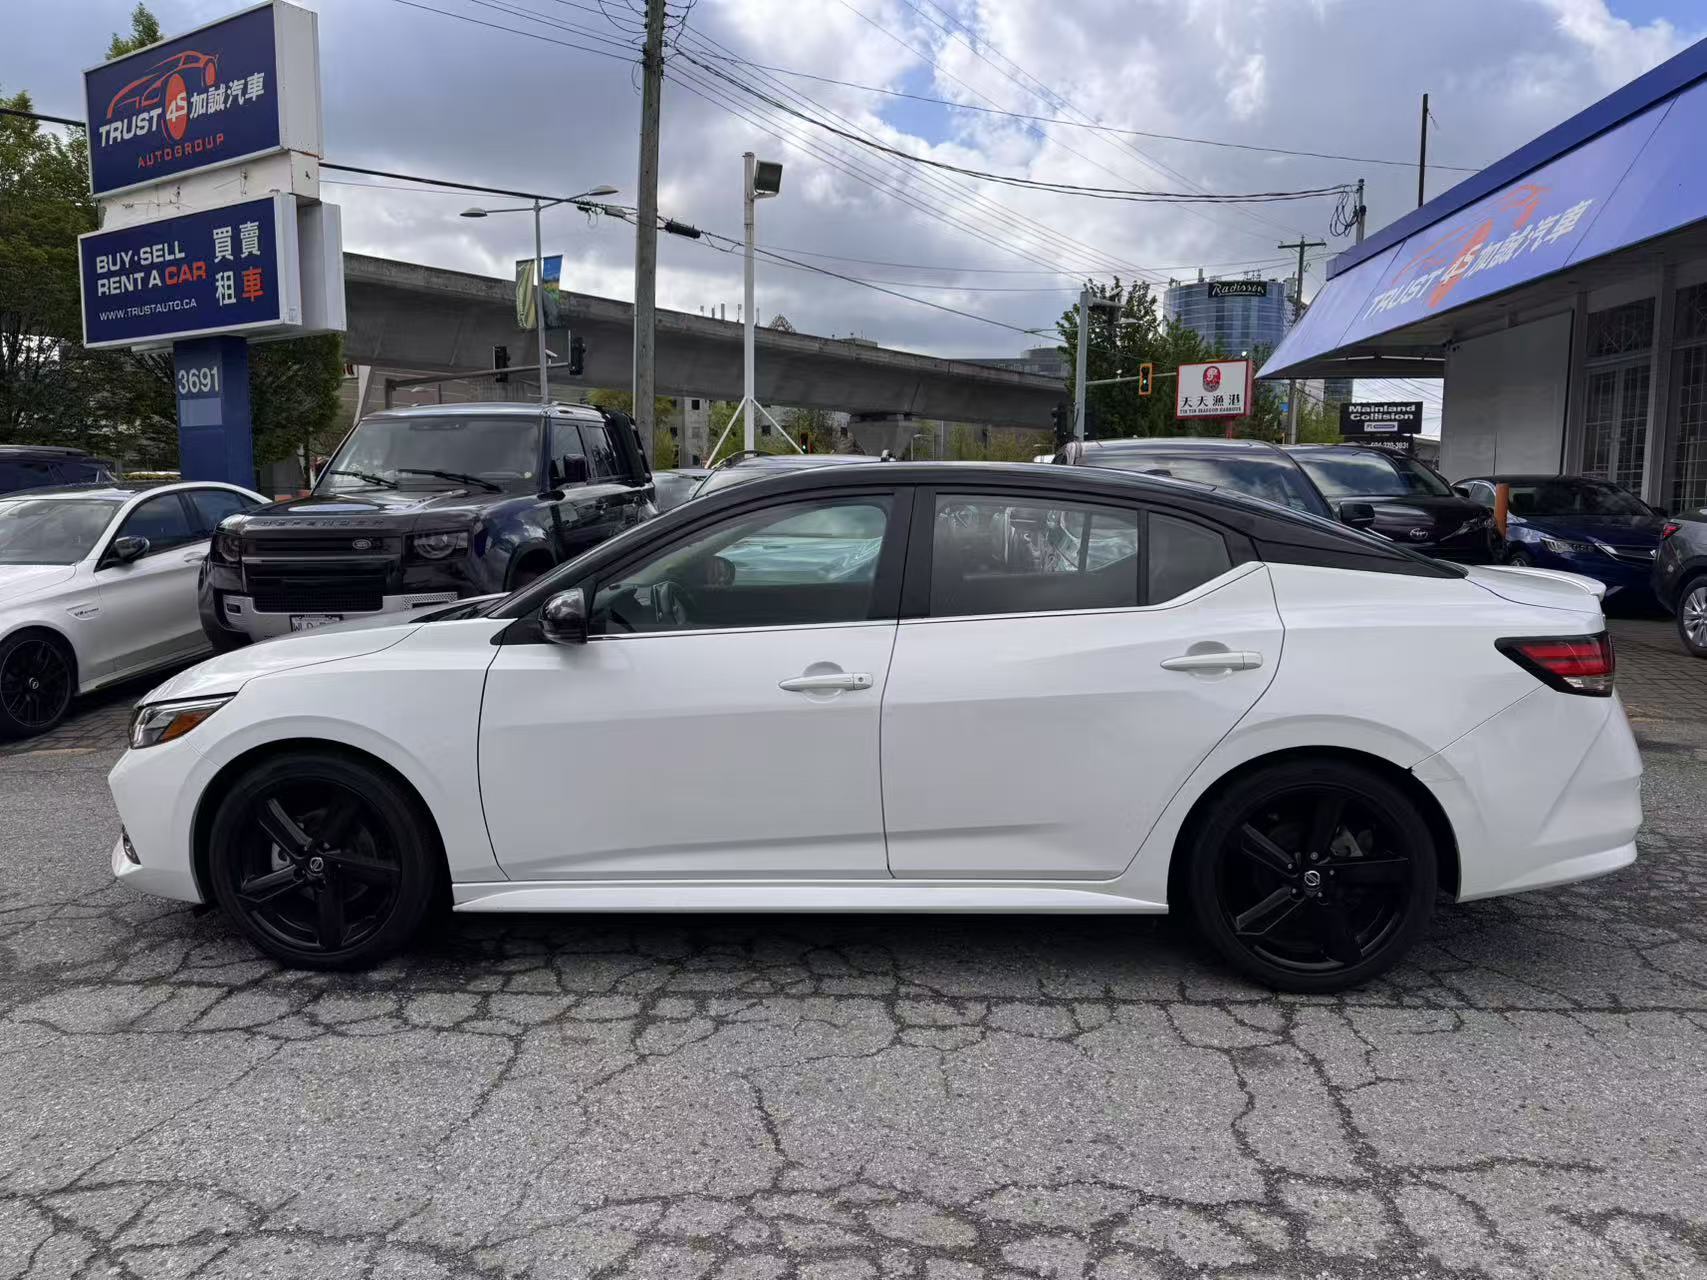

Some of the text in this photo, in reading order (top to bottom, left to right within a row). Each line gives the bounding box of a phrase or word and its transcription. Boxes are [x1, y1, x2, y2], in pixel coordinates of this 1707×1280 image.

[99, 72, 265, 148] TRUST 4S 加誠汽車
[138, 133, 225, 169] AUTOGROUP
[212, 220, 262, 264] 買賣
[1362, 267, 1445, 321] TRUST
[1463, 199, 1594, 280] 加誠汽車
[97, 261, 208, 298] RENT A CAR
[215, 266, 265, 307] 租車
[1212, 282, 1265, 296] Radisson
[99, 298, 198, 321] WWW.TRUSTAUTO.CA
[178, 365, 219, 395] 3691
[1348, 404, 1416, 412] Mainland
[1350, 412, 1414, 420] Collision
